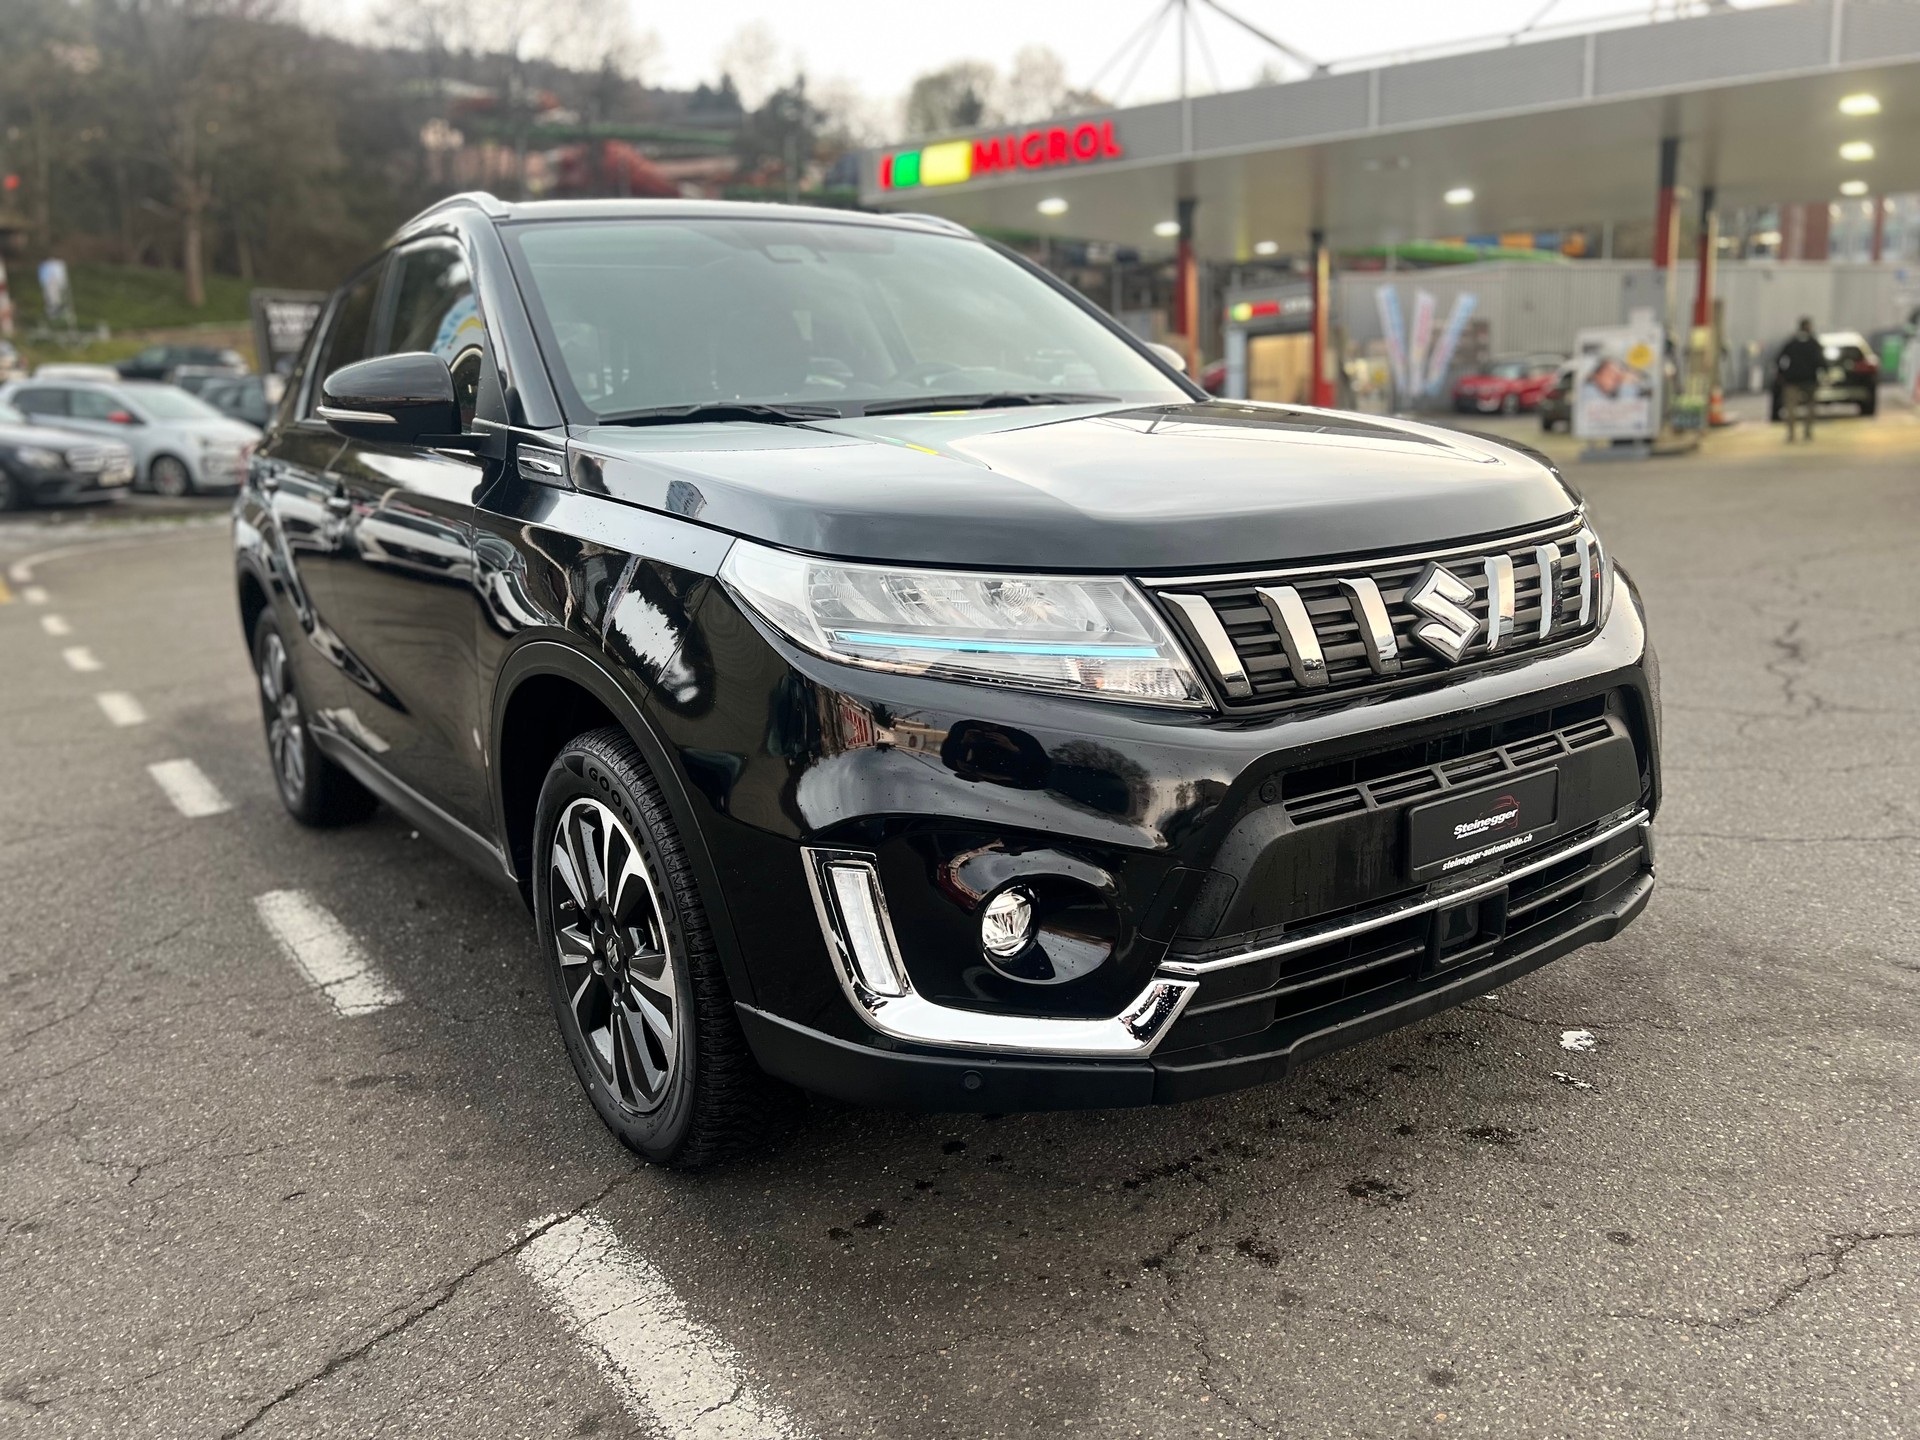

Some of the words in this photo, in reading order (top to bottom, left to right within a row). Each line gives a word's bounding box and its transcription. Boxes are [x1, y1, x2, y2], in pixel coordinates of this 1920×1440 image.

[971, 119, 1122, 177] MIGROL
[588, 766, 670, 912] GOODRIDE
[1453, 808, 1518, 835] Steinegger
[1442, 833, 1533, 870] steinegger-automobile.ch
